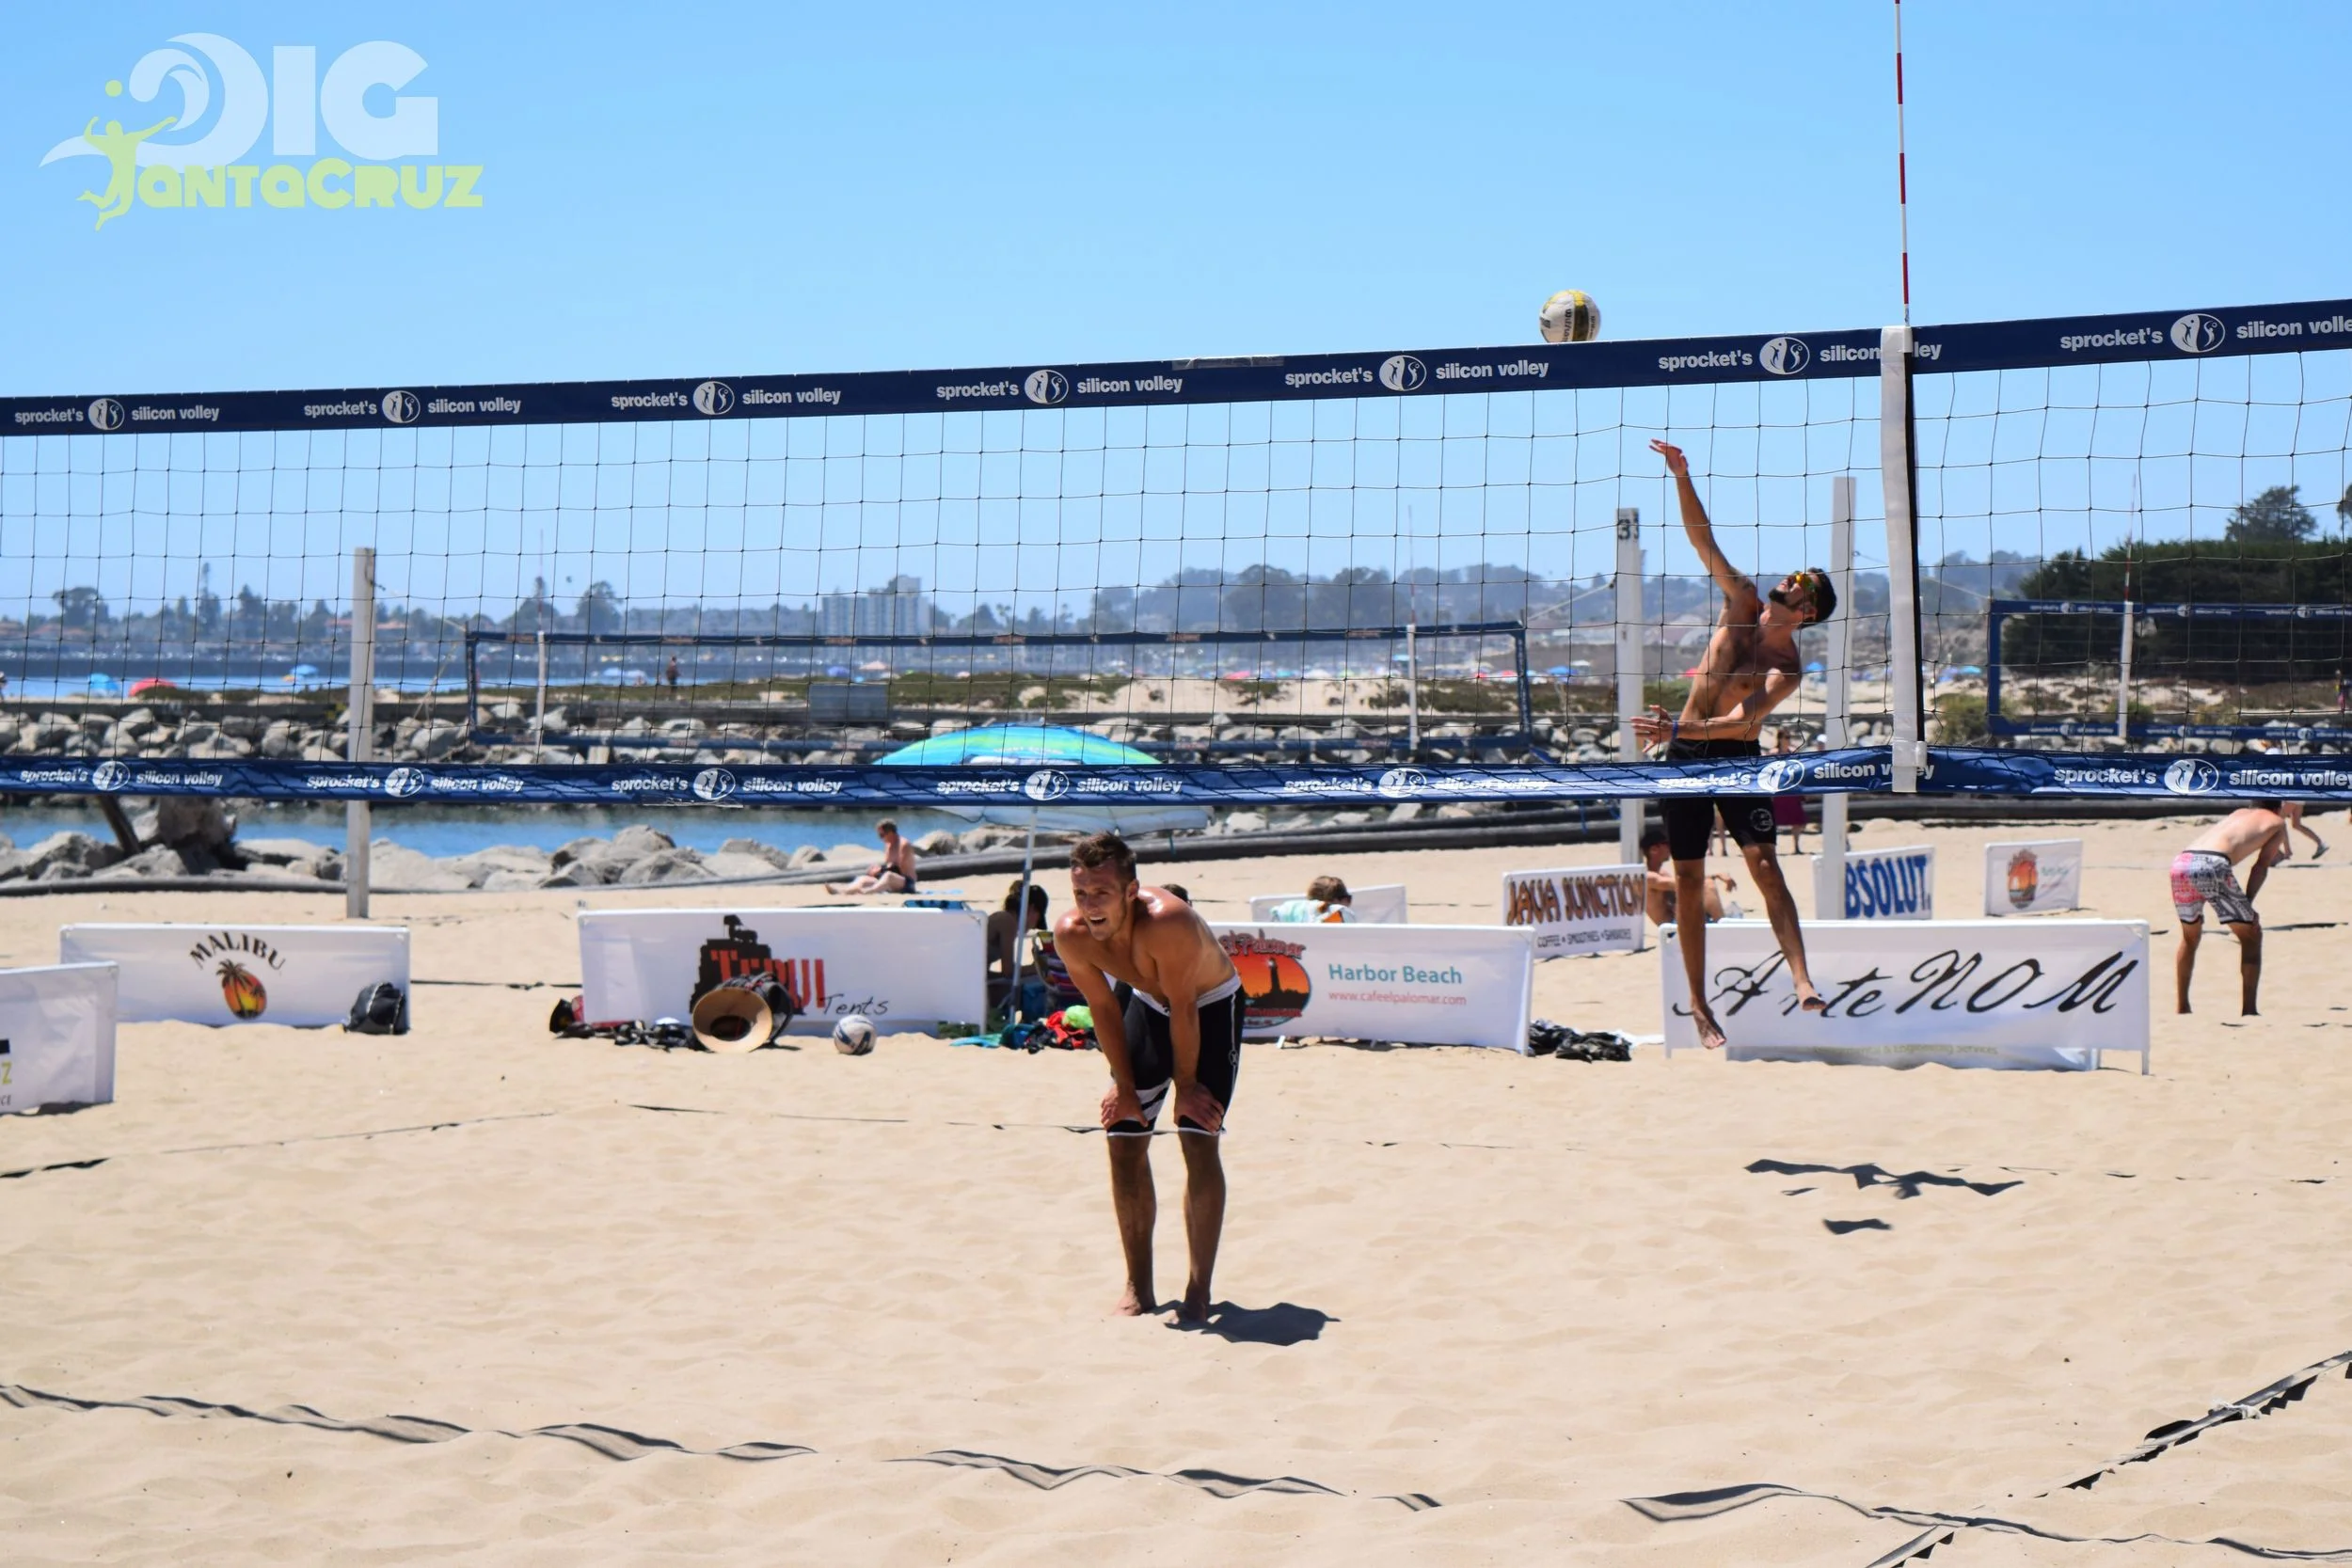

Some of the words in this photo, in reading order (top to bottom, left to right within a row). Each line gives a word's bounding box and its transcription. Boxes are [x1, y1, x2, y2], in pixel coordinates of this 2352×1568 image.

[2060, 327, 2164, 352] sprocket's
[2236, 320, 2302, 339] silicon
[2308, 315, 2352, 334] volle
[1658, 349, 1754, 372] sprocket's
[1819, 344, 1882, 362] silicon
[1285, 367, 1374, 388] sprocket's
[1436, 362, 1493, 380] silicon
[1497, 359, 1549, 378] volley
[611, 391, 689, 410] sprocket's
[742, 388, 792, 404] silicon
[796, 387, 841, 405] volley
[936, 380, 1020, 401] sprocket's
[1076, 377, 1131, 394] silicon
[1135, 375, 1183, 393] volley
[14, 407, 84, 425] sprocket's
[132, 405, 176, 420] silicon
[179, 404, 220, 421] volley
[304, 400, 377, 419] sprocket's
[427, 398, 475, 414] silicon
[479, 397, 521, 414] volley
[20, 768, 88, 784] sprocket's
[135, 770, 180, 784] silicon
[183, 772, 223, 786] volley
[1813, 762, 1876, 779] silicon
[2054, 767, 2157, 784] sprocket's
[2228, 769, 2295, 786] silicon
[306, 774, 379, 789] sprocket's
[431, 776, 477, 789] silicon
[482, 777, 524, 791] volley
[612, 776, 689, 793] sprocket's
[742, 777, 793, 792] silicon
[797, 778, 843, 795] volley
[936, 778, 1020, 795] sprocket's
[1075, 778, 1129, 792] silicon
[1135, 778, 1183, 795] volley
[1283, 776, 1373, 793] sprocket's
[1845, 854, 1927, 919] BSOLUT
[1506, 877, 1562, 927] JAVA
[190, 930, 286, 971] MALIBU
[1328, 963, 1397, 982] Harbor
[1403, 965, 1462, 984] Beach
[821, 993, 889, 1016] Tents
[1328, 990, 1467, 1006] www.cafeelpalomar.com
